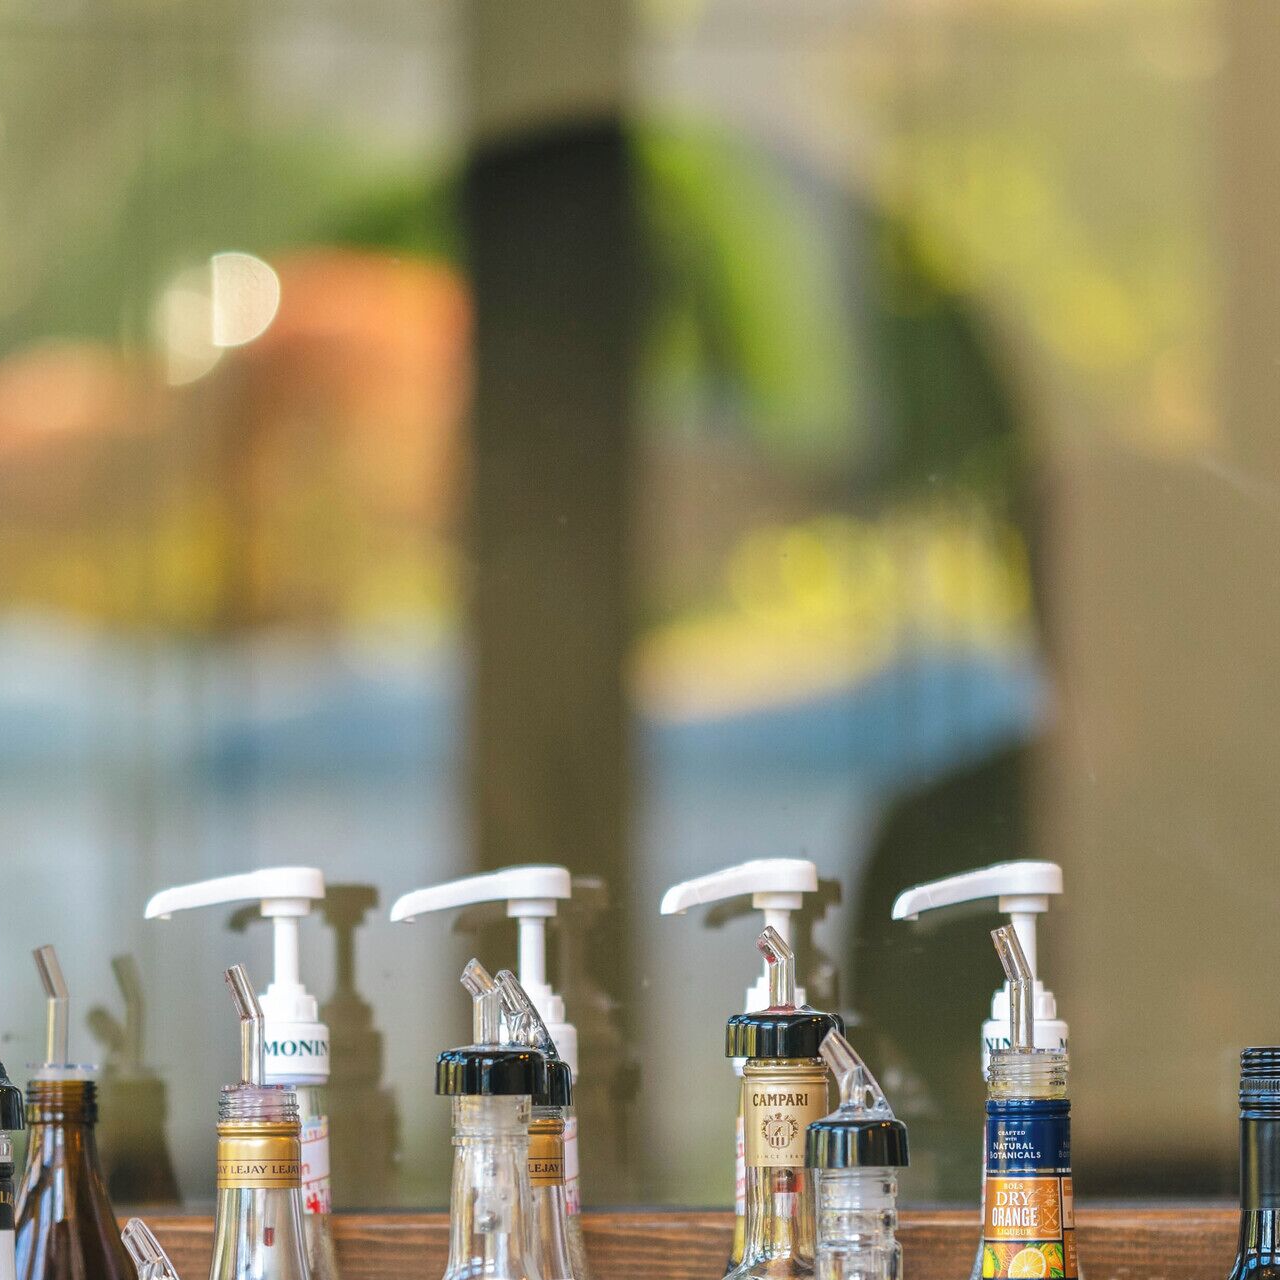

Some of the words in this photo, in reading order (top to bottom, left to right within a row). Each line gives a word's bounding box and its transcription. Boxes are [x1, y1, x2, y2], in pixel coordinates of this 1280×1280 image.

[753, 1093, 808, 1106] CAMPARI
[993, 1142, 1034, 1150] NATURAL
[990, 1151, 1041, 1159] BOTANICALS
[230, 1165, 268, 1174] LEJAY
[528, 1163, 560, 1173] LEJAY
[996, 1191, 1034, 1206] DRY
[992, 1207, 1038, 1227] ORANGE
